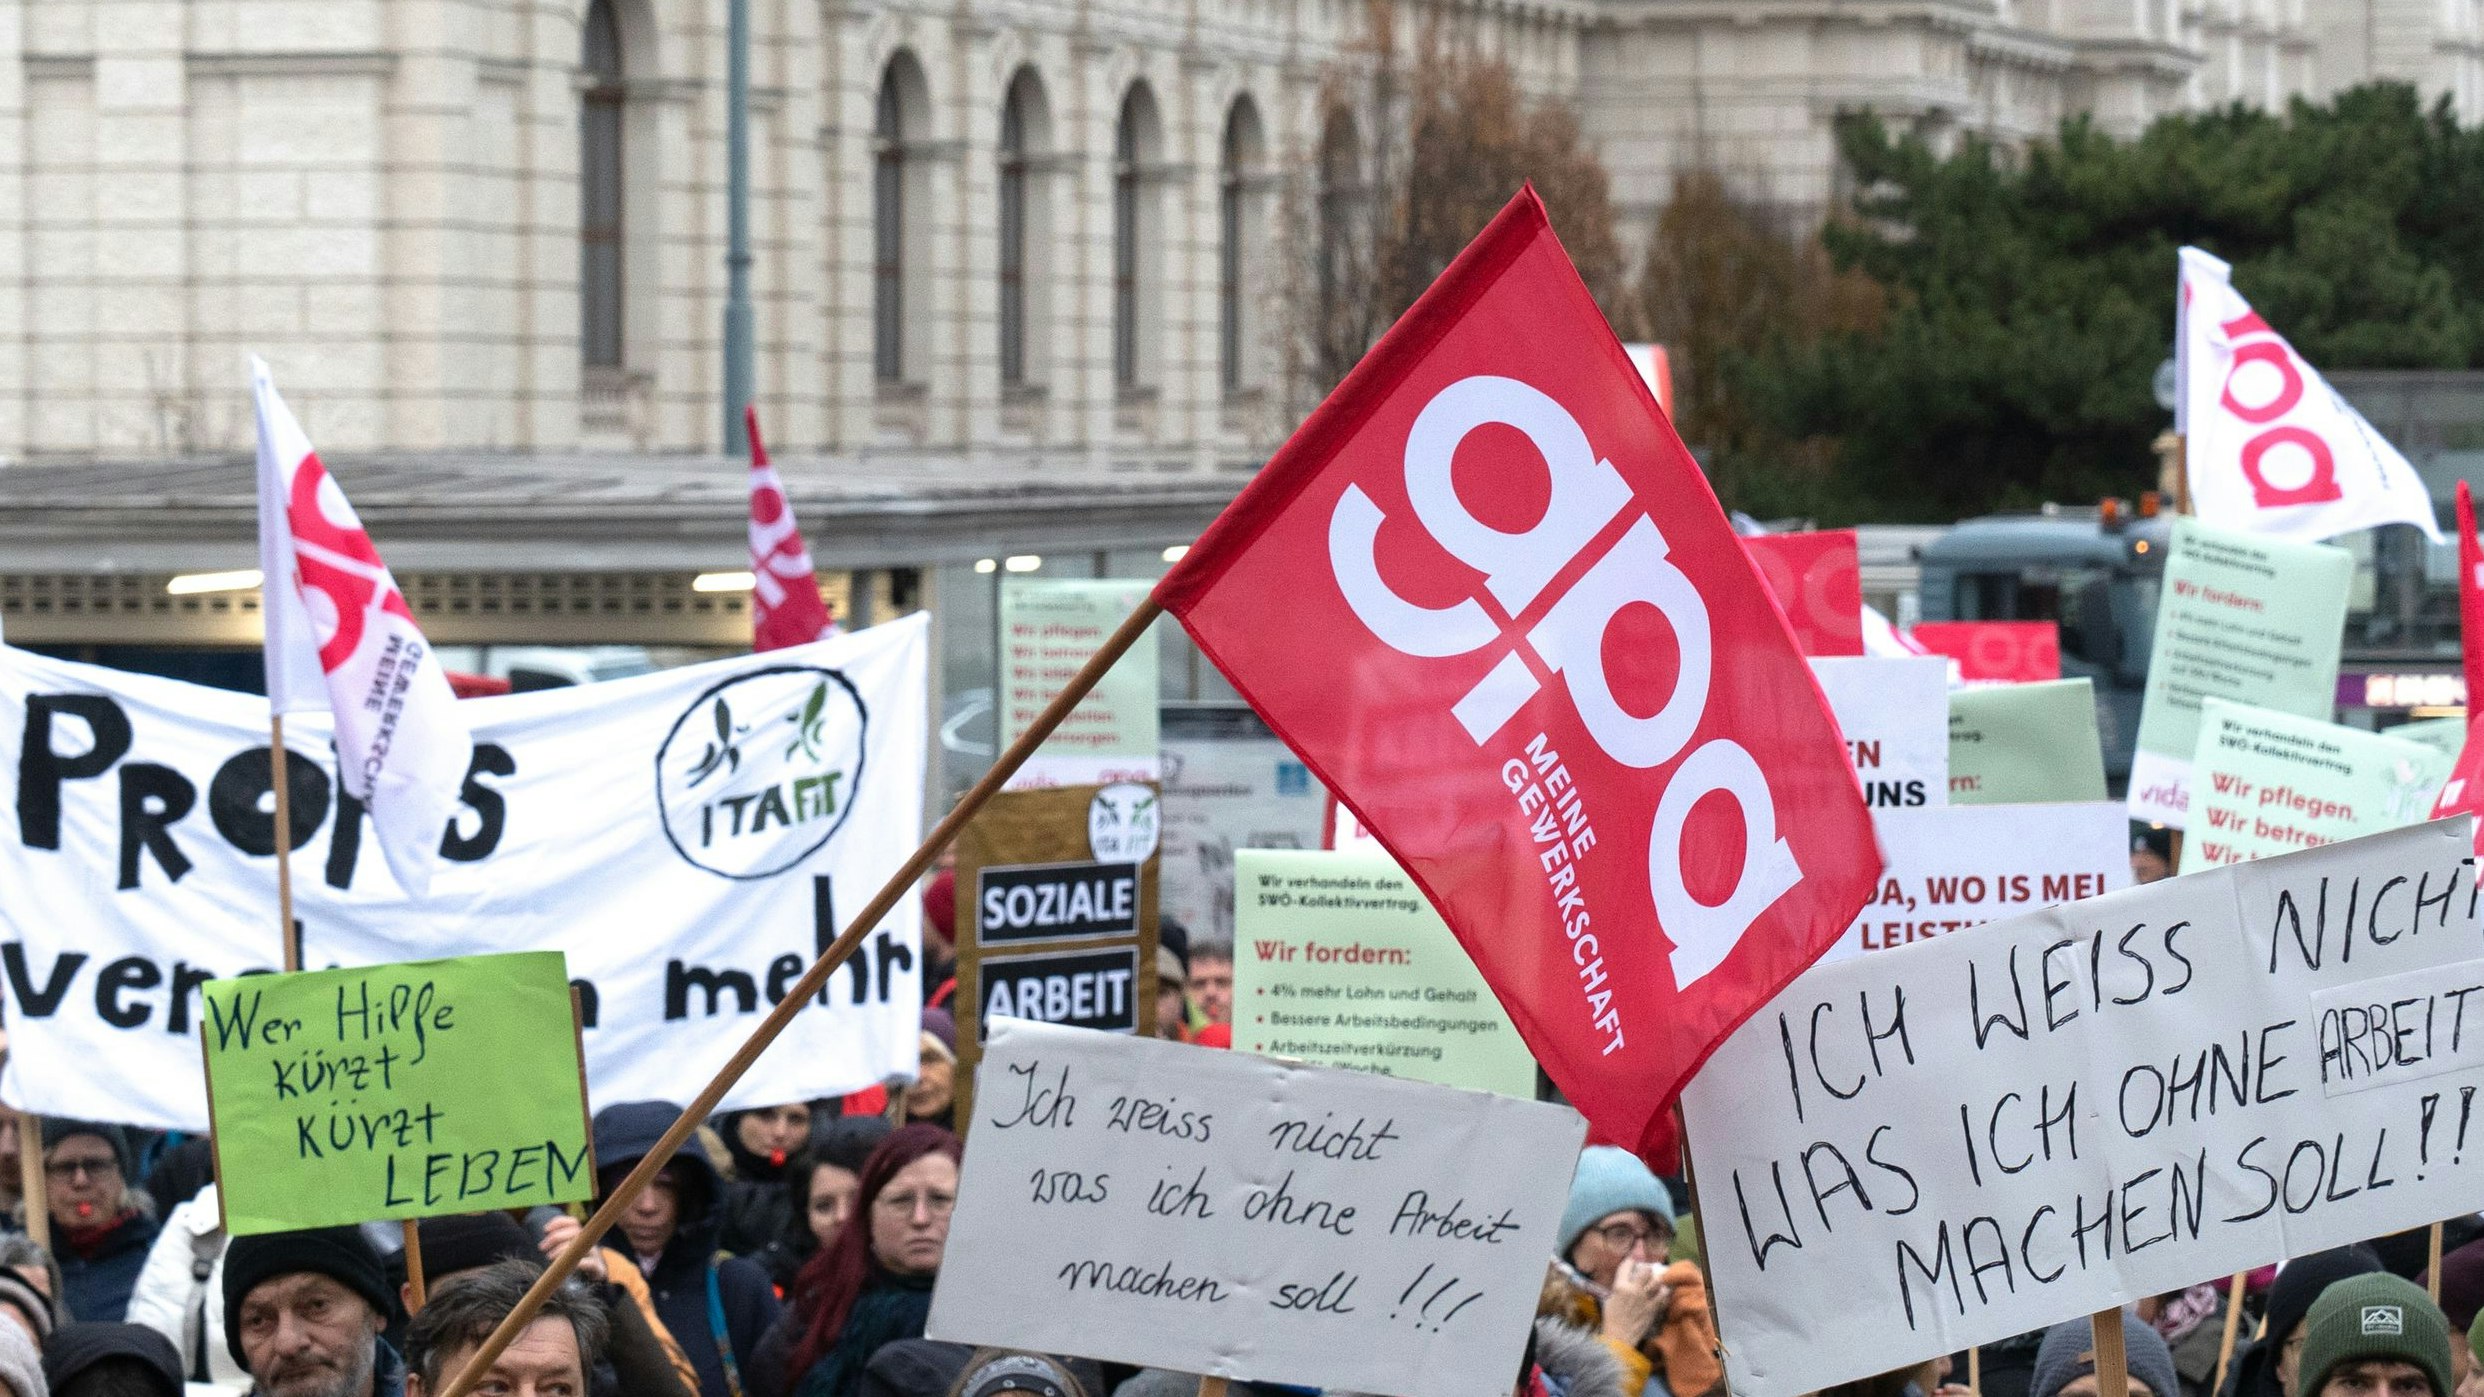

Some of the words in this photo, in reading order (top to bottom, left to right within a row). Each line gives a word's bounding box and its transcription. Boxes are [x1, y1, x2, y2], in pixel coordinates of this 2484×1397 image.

[1328, 375, 1805, 994] gpa
[1524, 732, 1597, 860] MEINE
[2207, 805, 2248, 831] Wir
[2212, 770, 2252, 798] Wir
[2258, 784, 2358, 824] pflegen.
[983, 877, 1134, 930] SOZIALE
[1258, 875, 1282, 888] Wir
[1288, 876, 1371, 890] verhandeln
[1374, 877, 1404, 890] den
[1501, 758, 1625, 1057] GEWERKSCHAFT
[1926, 875, 1987, 904] WO
[1997, 874, 2031, 902] IS
[665, 875, 914, 1021] mehr
[1255, 940, 1297, 964] Wir
[1306, 940, 1412, 965] fordern:
[208, 990, 301, 1052] Wer
[337, 981, 454, 1066] Hilfe
[983, 968, 1132, 1027] ARBEIT
[1270, 984, 1296, 998] 4%
[1300, 984, 1341, 998] mehr
[1346, 985, 1385, 1000] Lohn
[1389, 987, 1420, 1001] und
[1423, 987, 1478, 1003] Gehalt
[1270, 1010, 1331, 1026] Bessere
[1335, 1012, 1498, 1034] Arbeitsbedingungen
[1778, 984, 1915, 1124] ICH
[1968, 920, 2193, 1050] WEISS
[991, 1059, 1075, 1129] Ich
[1107, 1097, 1214, 1143] weiss
[1269, 1110, 1400, 1161] nicht
[1733, 1125, 1919, 1272] WAS
[1960, 1080, 2079, 1188] ICH
[2118, 1020, 2299, 1138] OHNE
[2319, 985, 2484, 1084] ARBEIT
[385, 1139, 588, 1208] LEBEN
[1030, 1167, 1109, 1204] was
[1148, 1166, 1214, 1220] ich
[1244, 1169, 1356, 1236] ohne
[1389, 1189, 1521, 1245] Arbeit
[1897, 1147, 2206, 1331] MACHEN
[1058, 1258, 1230, 1303] machen
[1270, 1271, 1355, 1314] soll
